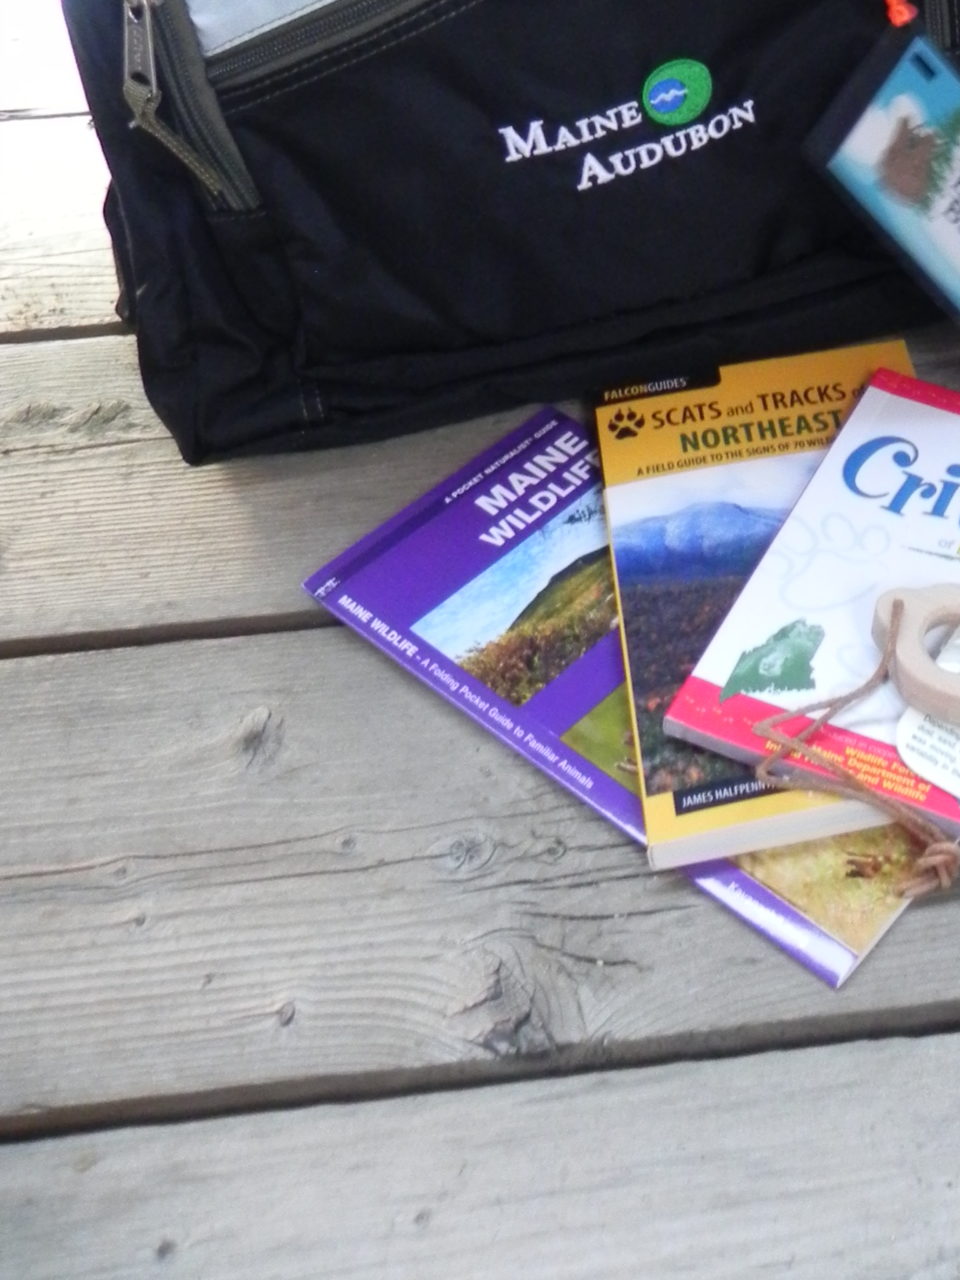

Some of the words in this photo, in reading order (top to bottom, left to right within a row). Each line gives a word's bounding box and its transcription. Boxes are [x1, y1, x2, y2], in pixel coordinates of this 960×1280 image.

[498, 99, 643, 163] MAINE
[576, 99, 757, 191] AUDUBON
[651, 401, 722, 430] SCATS
[727, 401, 755, 418] and
[757, 383, 847, 412] TRACKS
[680, 409, 843, 453] NORTHEAST
[474, 431, 589, 516] MAINE
[636, 467, 644, 476] A
[646, 460, 675, 476] FIELD
[677, 456, 708, 470] GUIDE
[710, 453, 723, 463] TO
[725, 450, 744, 461] THE
[746, 444, 777, 458] SIGNS
[778, 442, 792, 452] OF
[794, 440, 806, 450] 70
[338, 594, 374, 623] MAINE
[370, 617, 419, 657] WILDLIFE
[421, 658, 430, 669] A
[429, 662, 459, 691] Folding
[459, 685, 490, 712] Pocket
[488, 707, 514, 731] Guide
[514, 726, 525, 737] to
[524, 733, 559, 763] Familiar
[557, 759, 595, 790] Animals
[682, 790, 713, 810] JAMES
